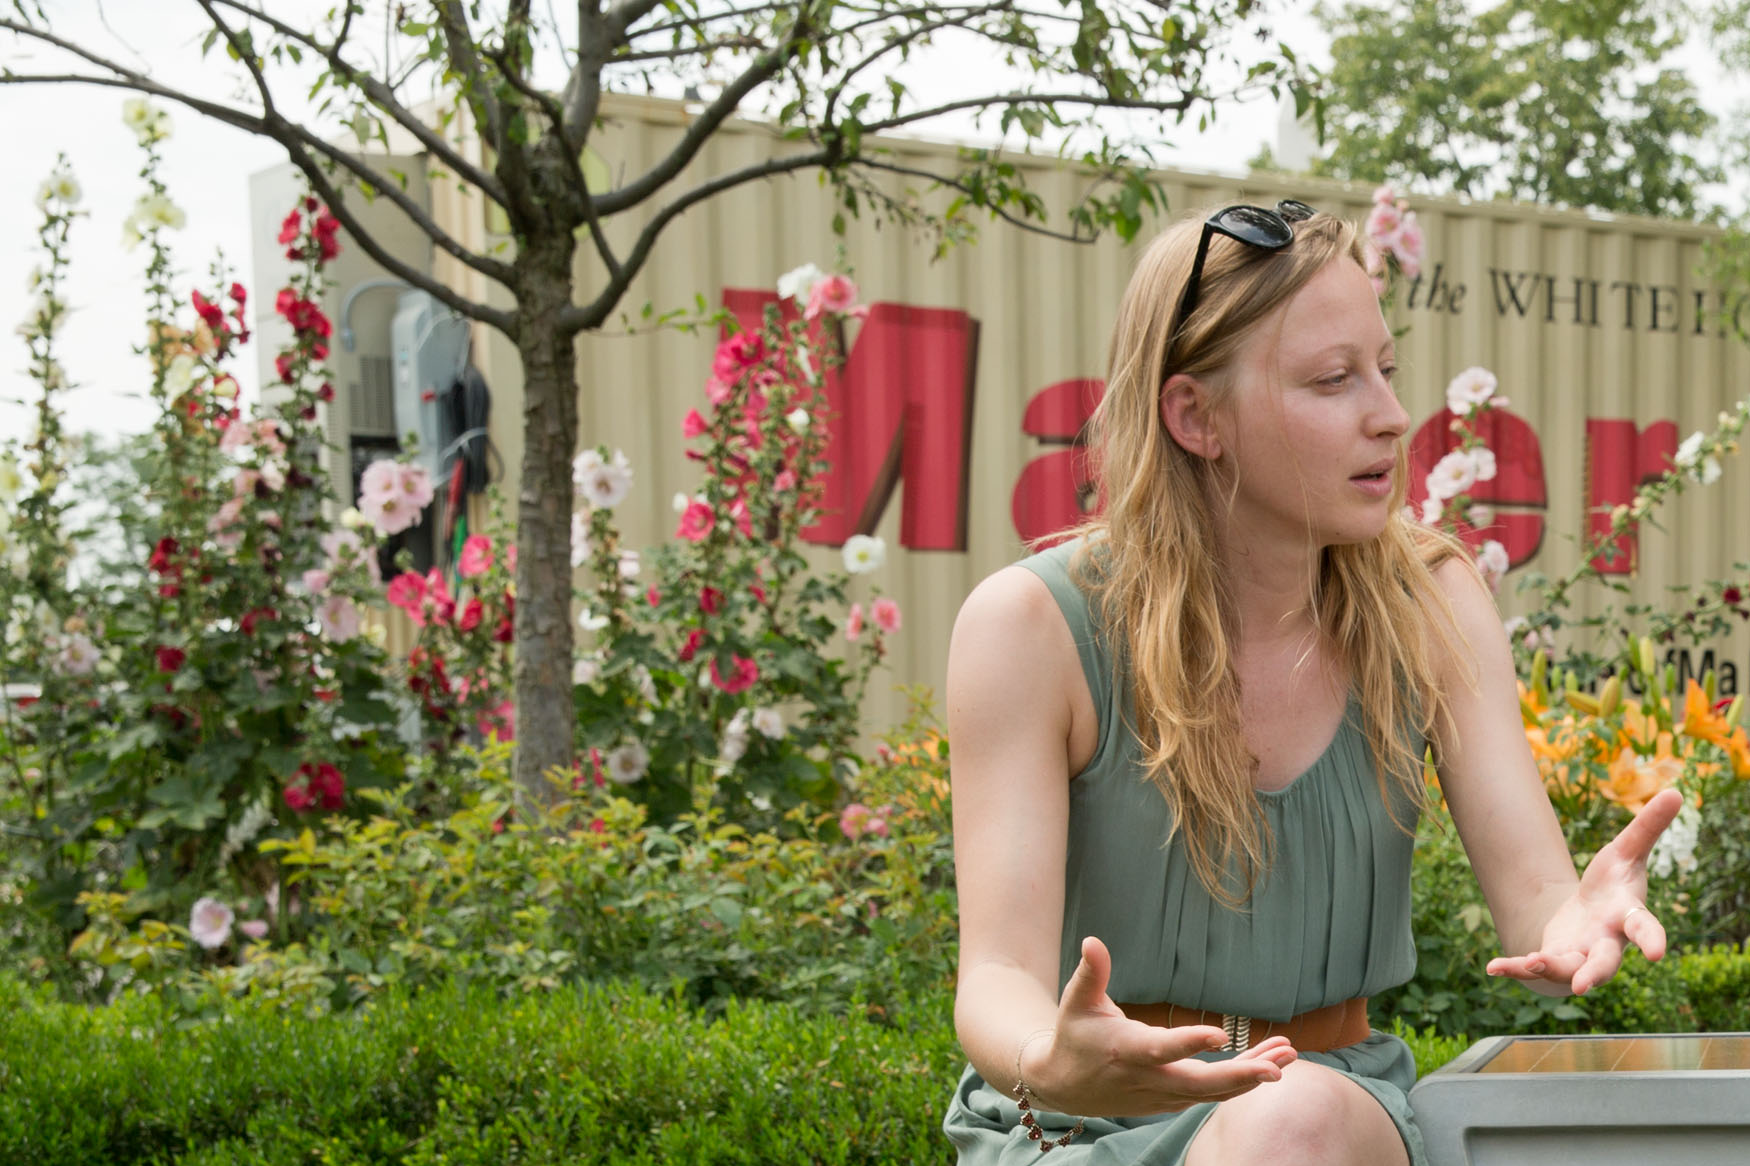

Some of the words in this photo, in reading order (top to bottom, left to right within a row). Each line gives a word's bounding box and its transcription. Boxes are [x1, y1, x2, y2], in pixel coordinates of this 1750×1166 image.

[1407, 263, 1467, 315] the
[1488, 268, 1681, 334] WHITE
[716, 286, 1680, 577] Maer
